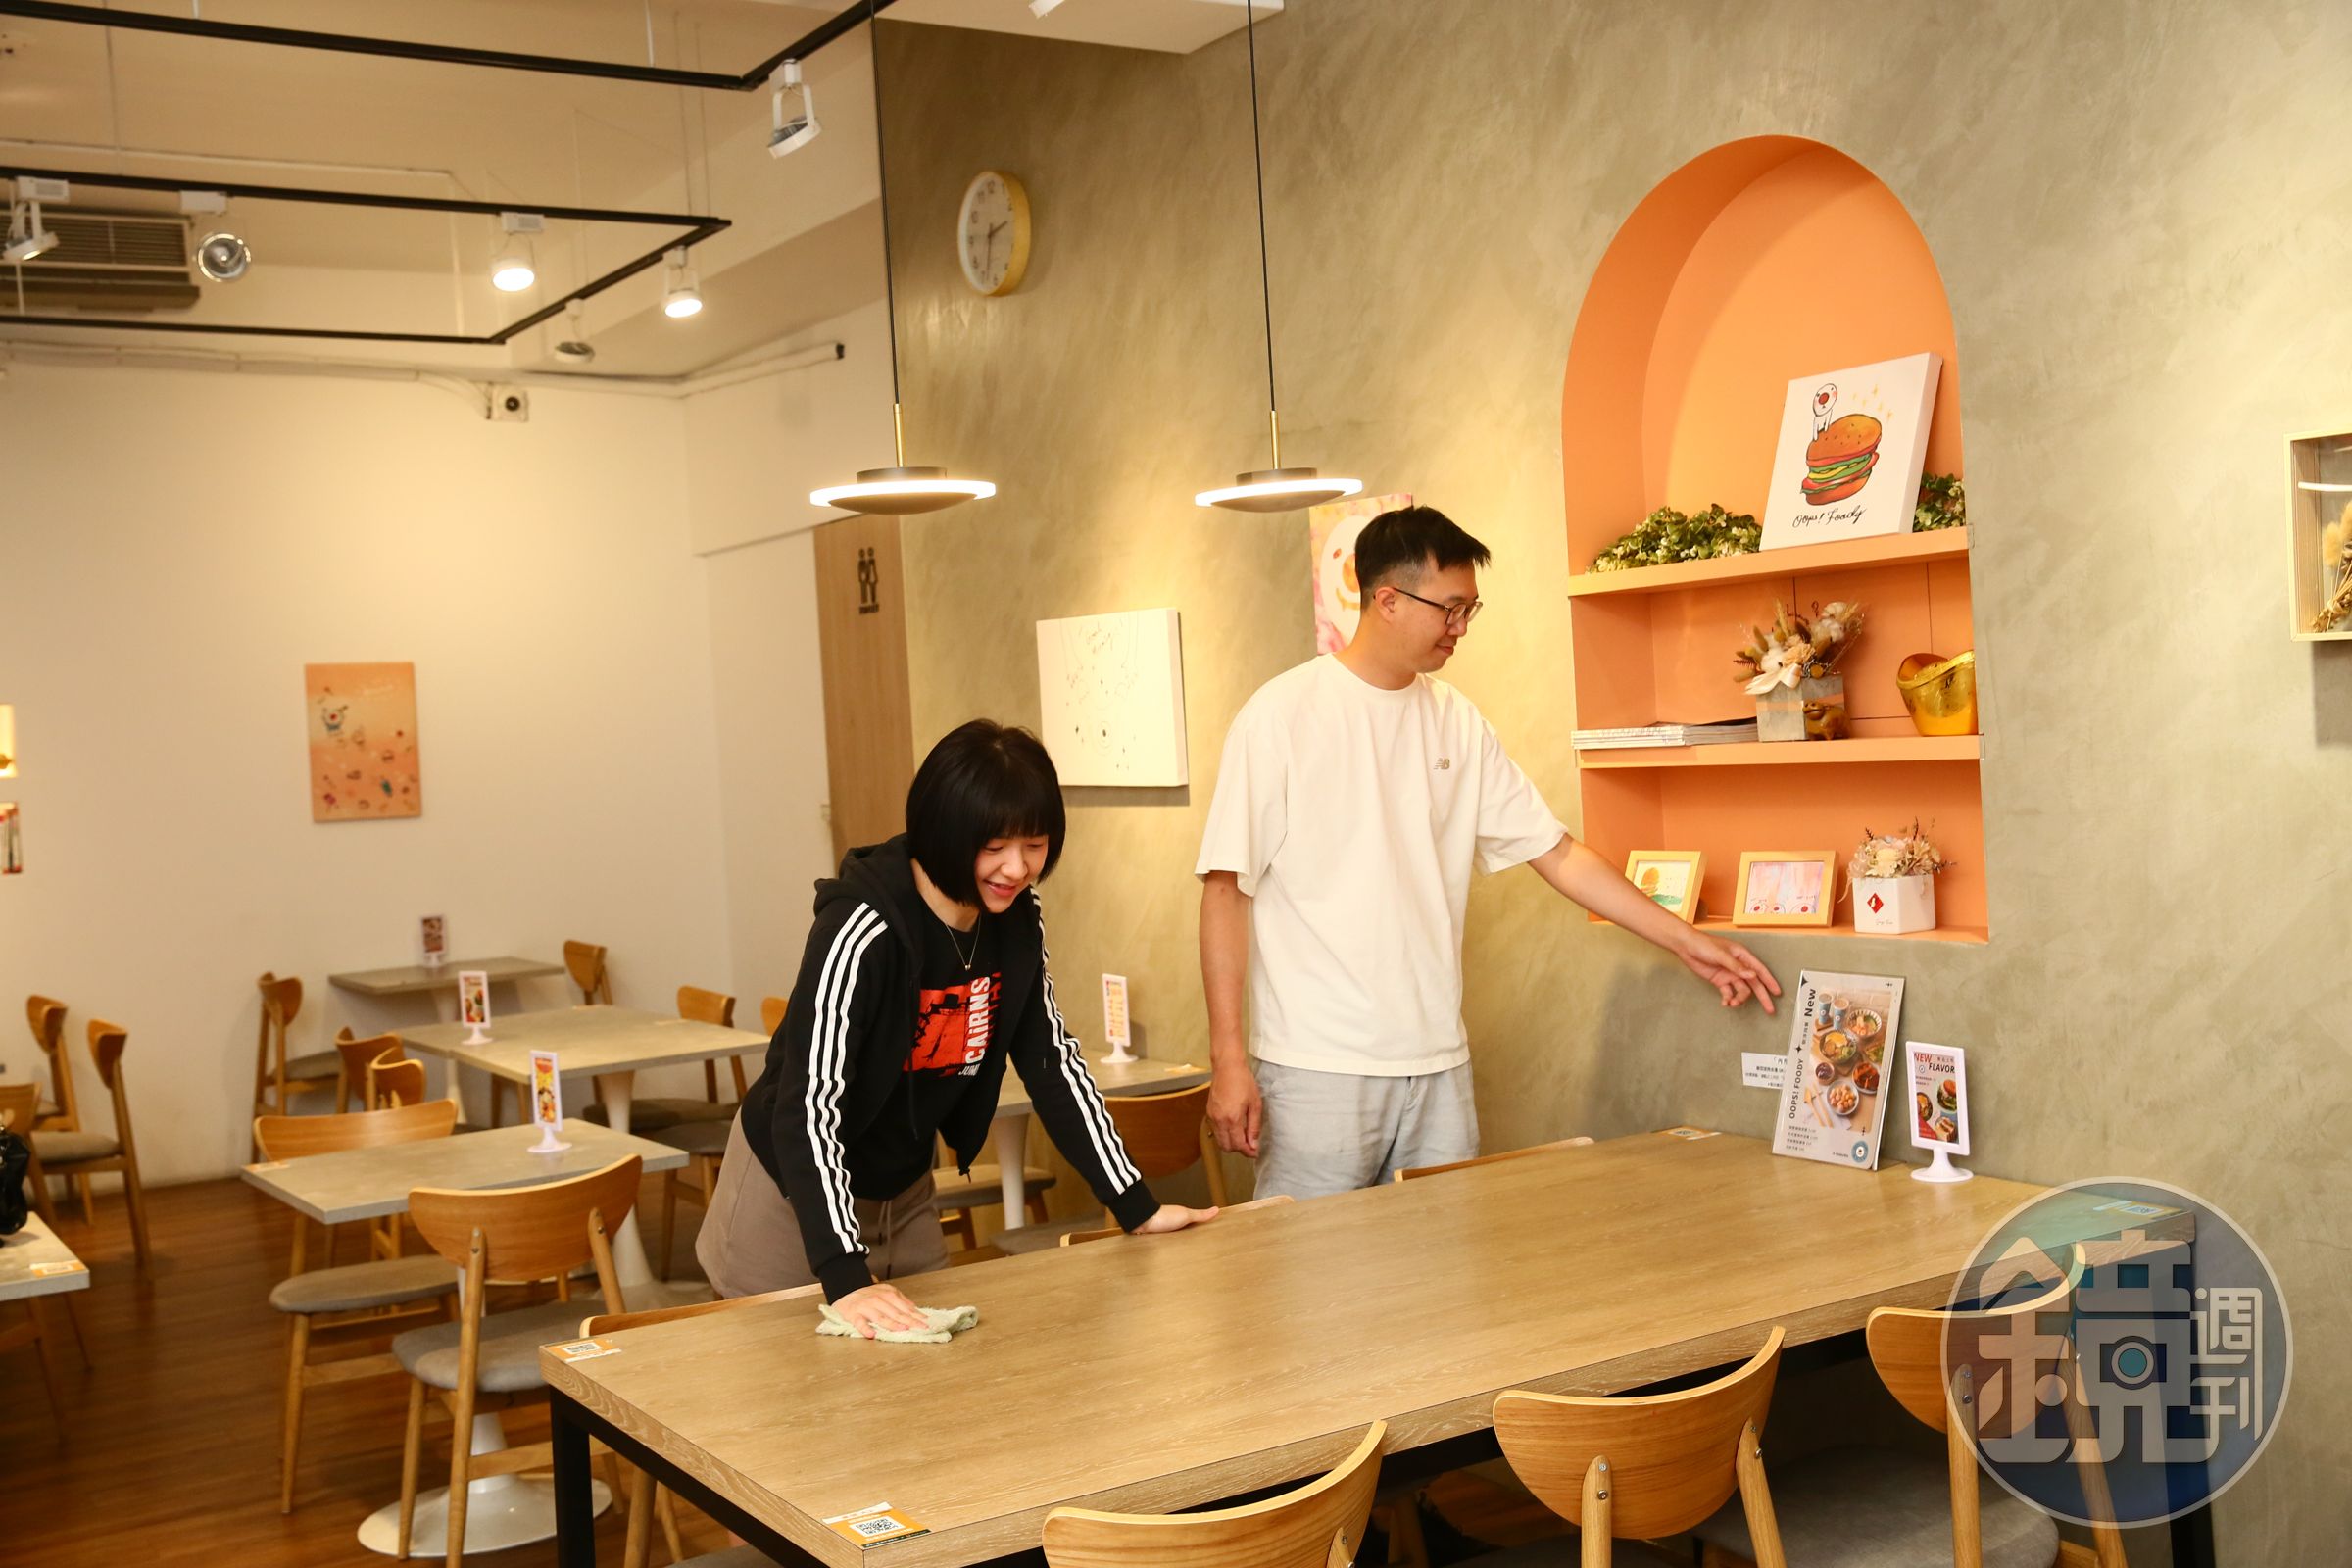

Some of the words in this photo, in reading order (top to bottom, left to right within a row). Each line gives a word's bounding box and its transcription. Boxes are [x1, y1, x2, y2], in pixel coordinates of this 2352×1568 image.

[1792, 513, 1825, 528] Oops!
[1825, 505, 1868, 526] Foody
[1804, 989, 1816, 1017] New
[1914, 1053, 1933, 1063] NEW
[1928, 1062, 1956, 1074] FLAVOR
[1793, 1058, 1804, 1089] FOODY
[1788, 1091, 1799, 1119] OOPS!
